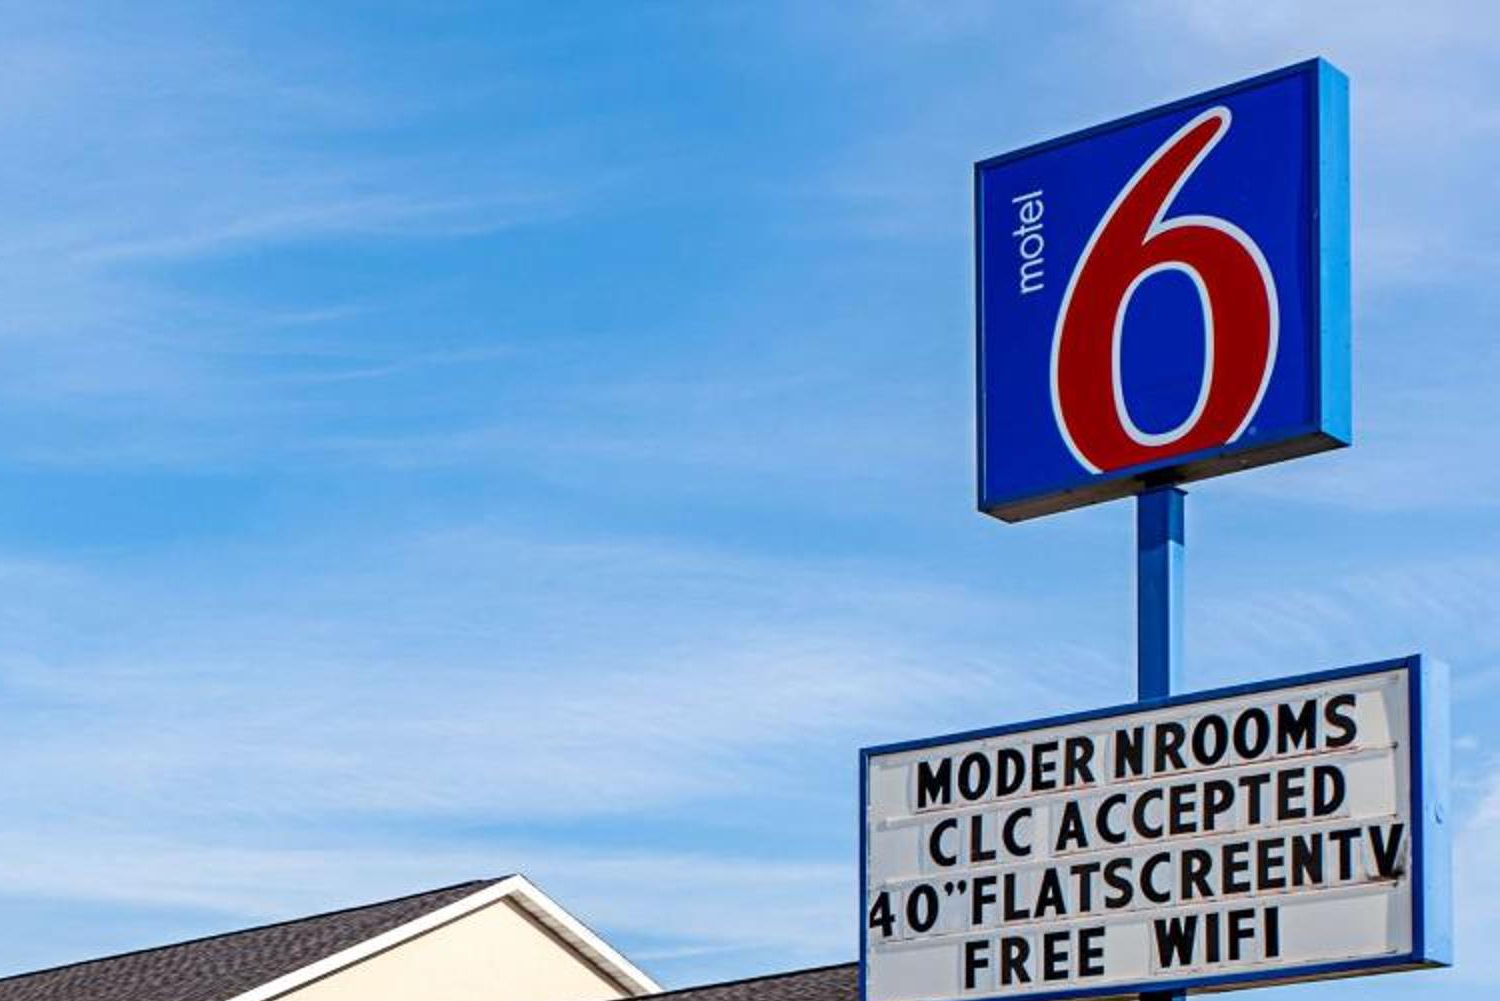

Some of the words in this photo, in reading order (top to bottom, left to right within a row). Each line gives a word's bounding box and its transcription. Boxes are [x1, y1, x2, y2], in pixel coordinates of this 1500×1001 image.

[1012, 189, 1045, 295] motel
[1049, 105, 1280, 475] 6
[929, 808, 1033, 867] CLC
[1056, 765, 1346, 851] ACCEPTED
[964, 927, 1105, 989] FREE
[1155, 906, 1280, 968] WIFI
